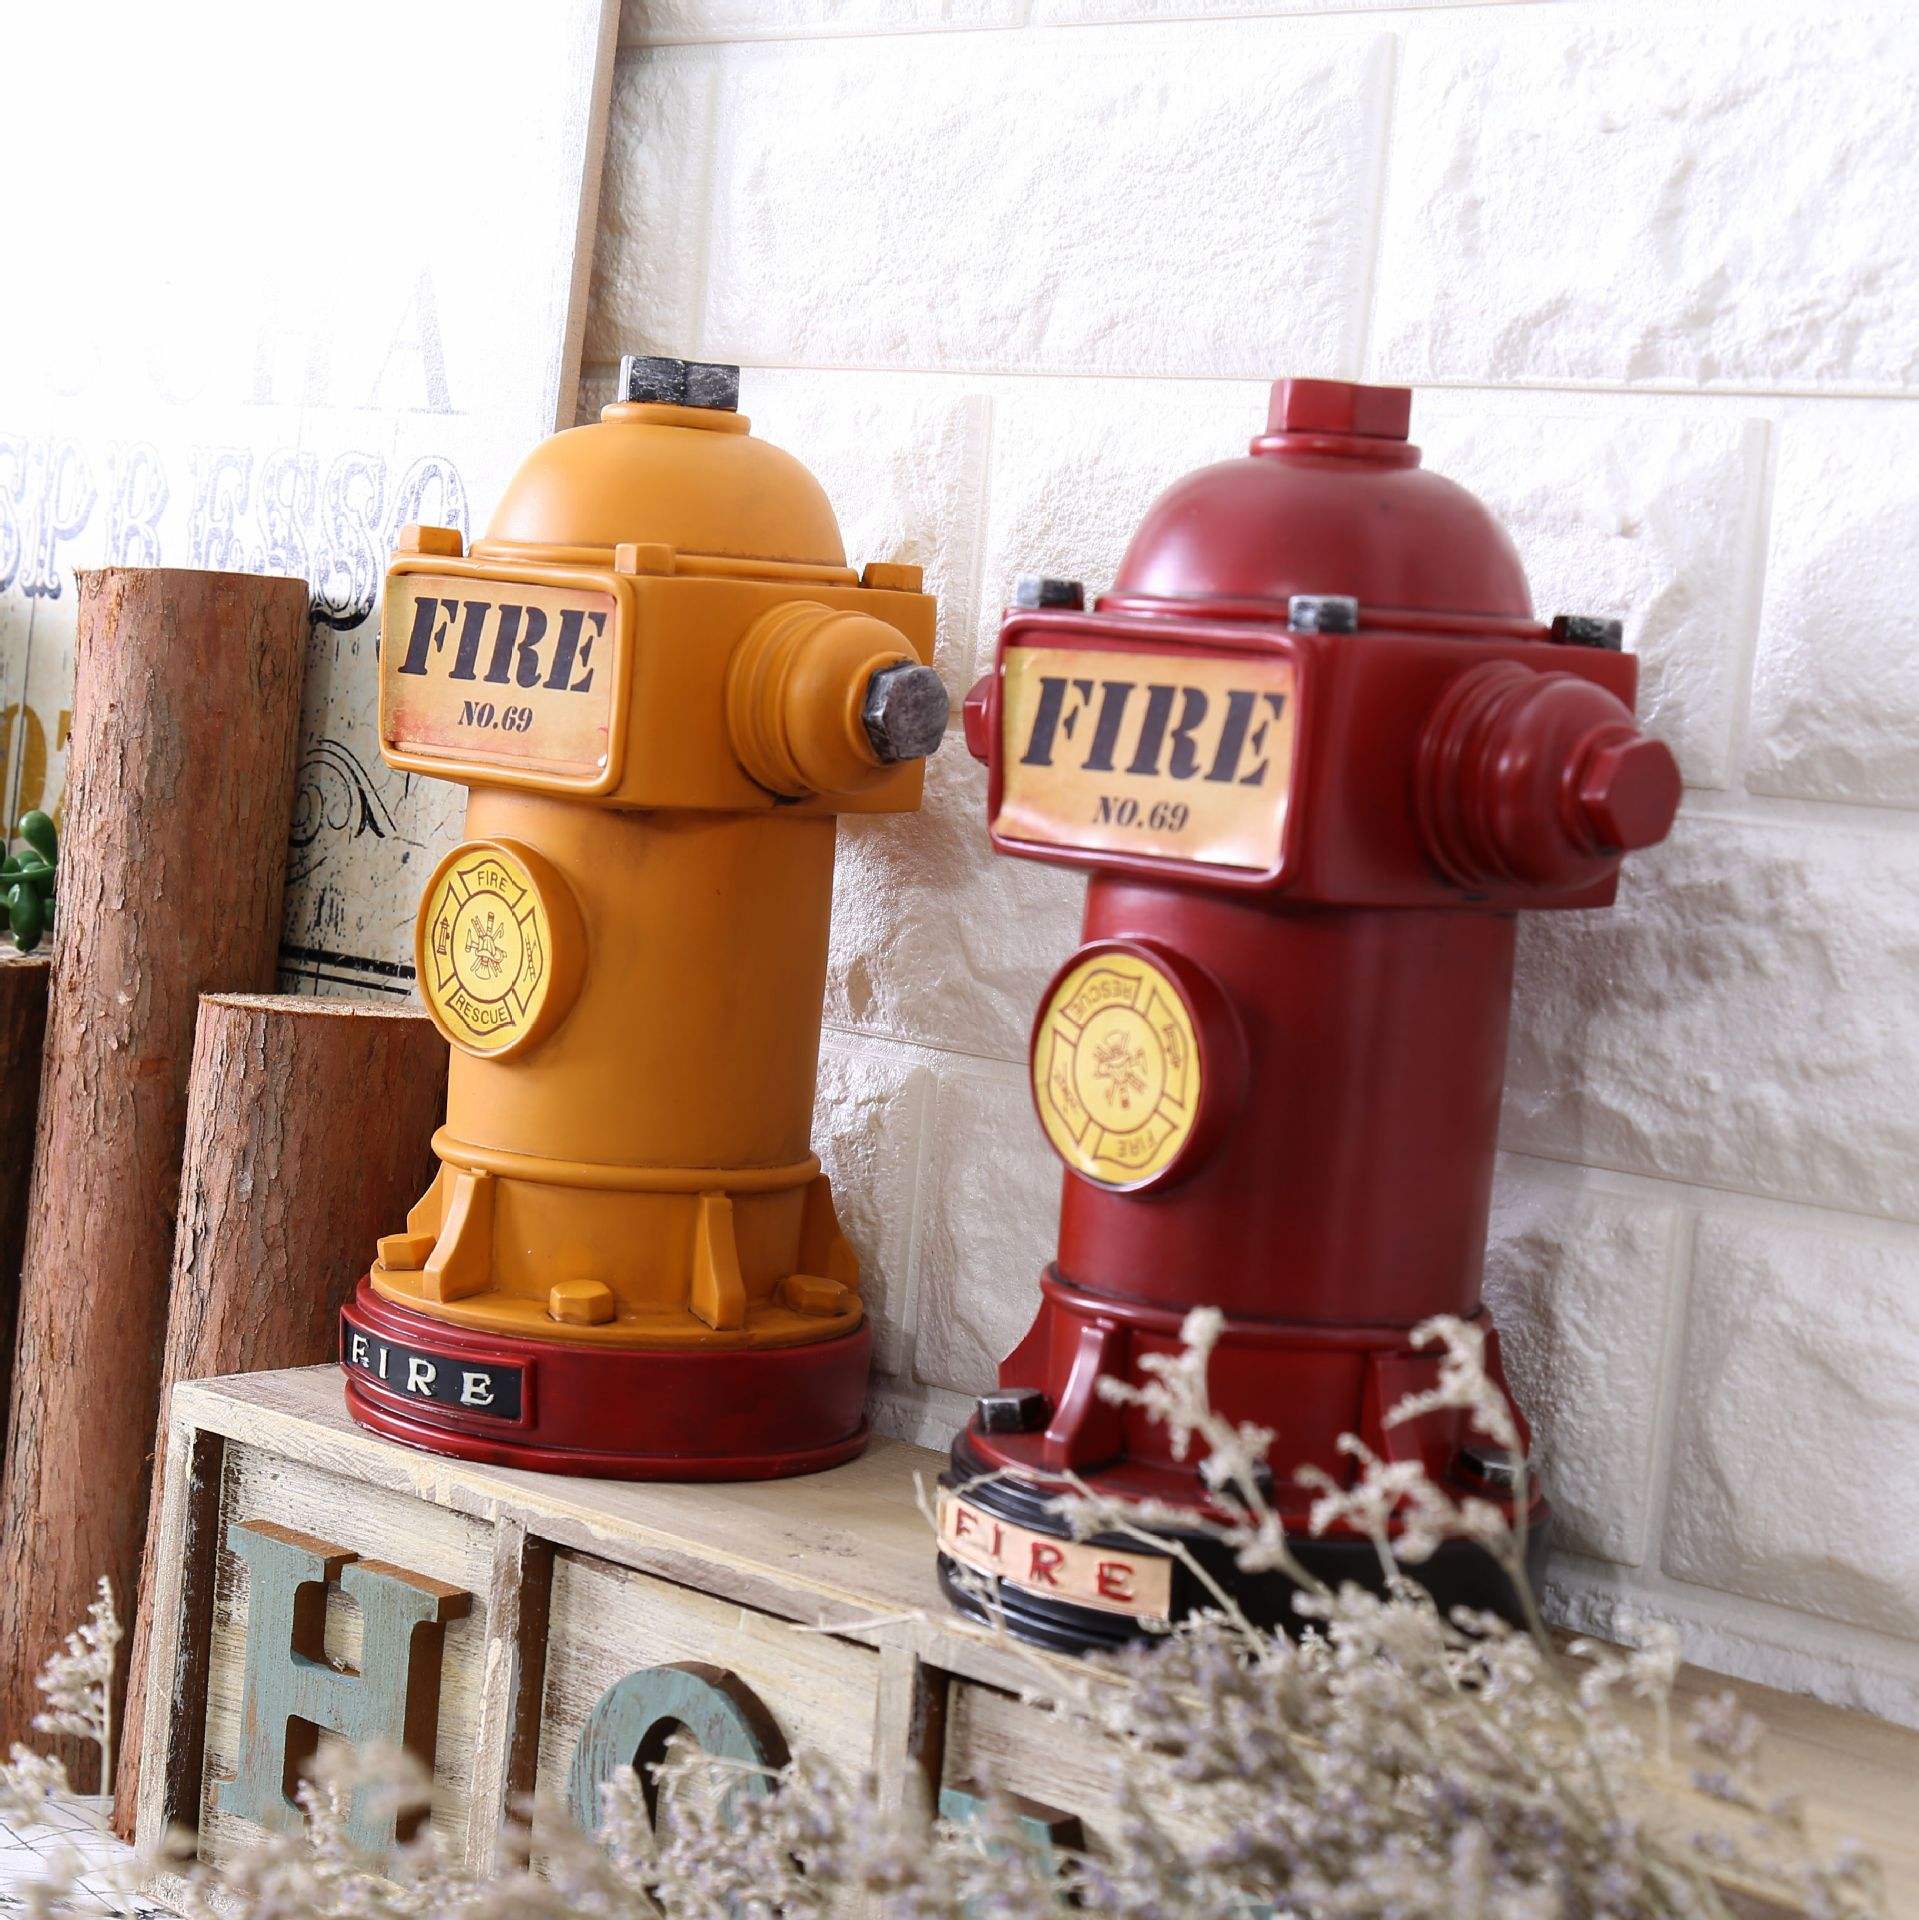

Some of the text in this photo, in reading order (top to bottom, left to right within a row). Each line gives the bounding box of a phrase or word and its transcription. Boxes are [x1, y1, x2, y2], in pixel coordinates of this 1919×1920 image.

[397, 596, 607, 693] FIRE
[457, 700, 533, 733] NO.69
[1020, 676, 1285, 786] FIRE
[1093, 796, 1191, 833] NO.69
[477, 870, 508, 893] FIRE
[455, 994, 508, 1025] RESCUE
[352, 1333, 495, 1406] FIRE
[955, 1507, 1136, 1603] FIRE
